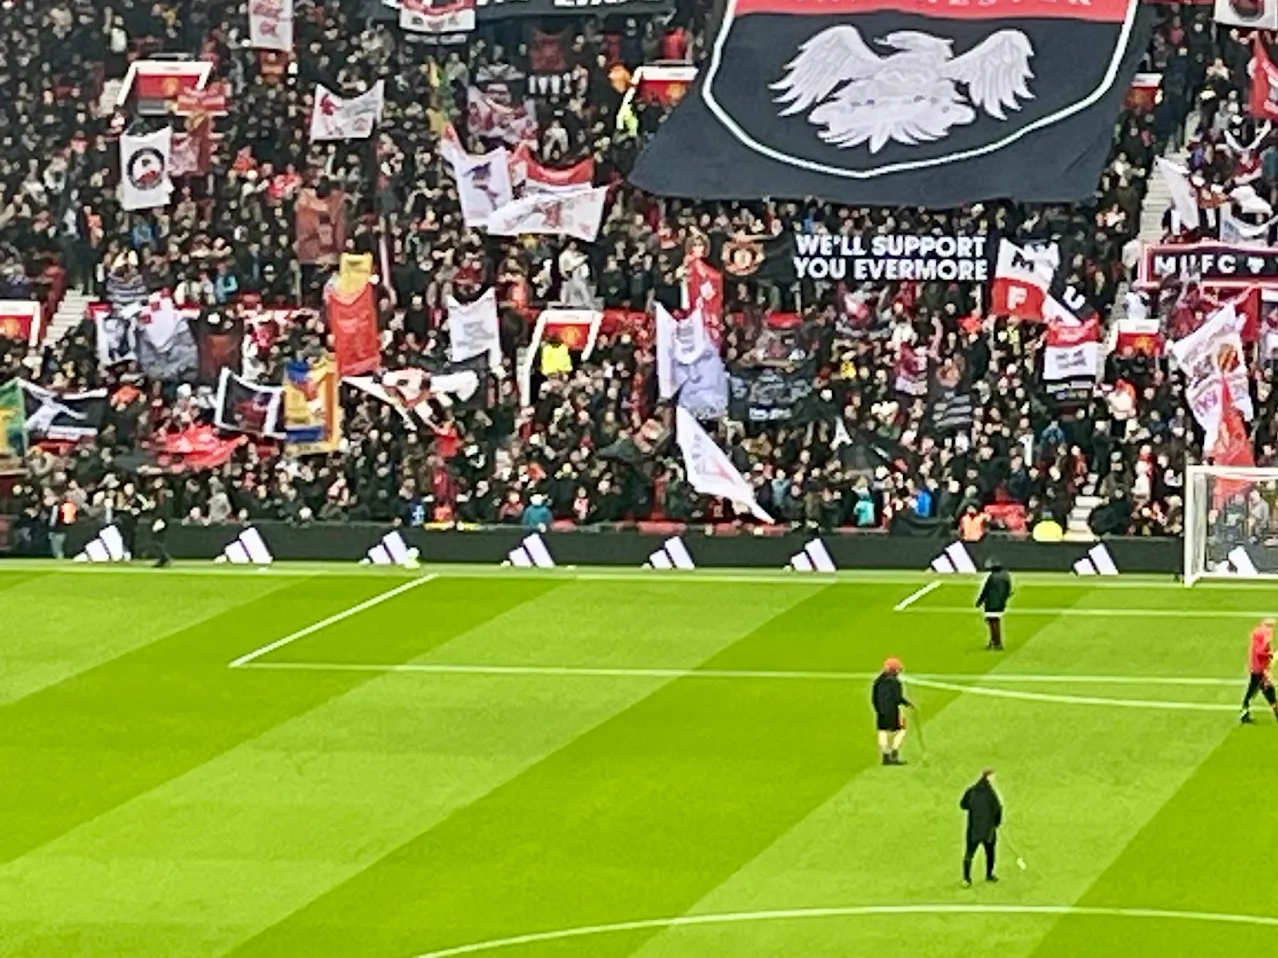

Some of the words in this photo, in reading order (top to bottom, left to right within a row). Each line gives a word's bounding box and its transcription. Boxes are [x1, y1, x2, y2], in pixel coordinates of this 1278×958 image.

[795, 234, 866, 257] WE'LL
[871, 235, 986, 258] SUPPORT
[793, 257, 846, 280] YOU
[854, 258, 988, 281] EVERMORE
[1154, 254, 1236, 275] MUFC
